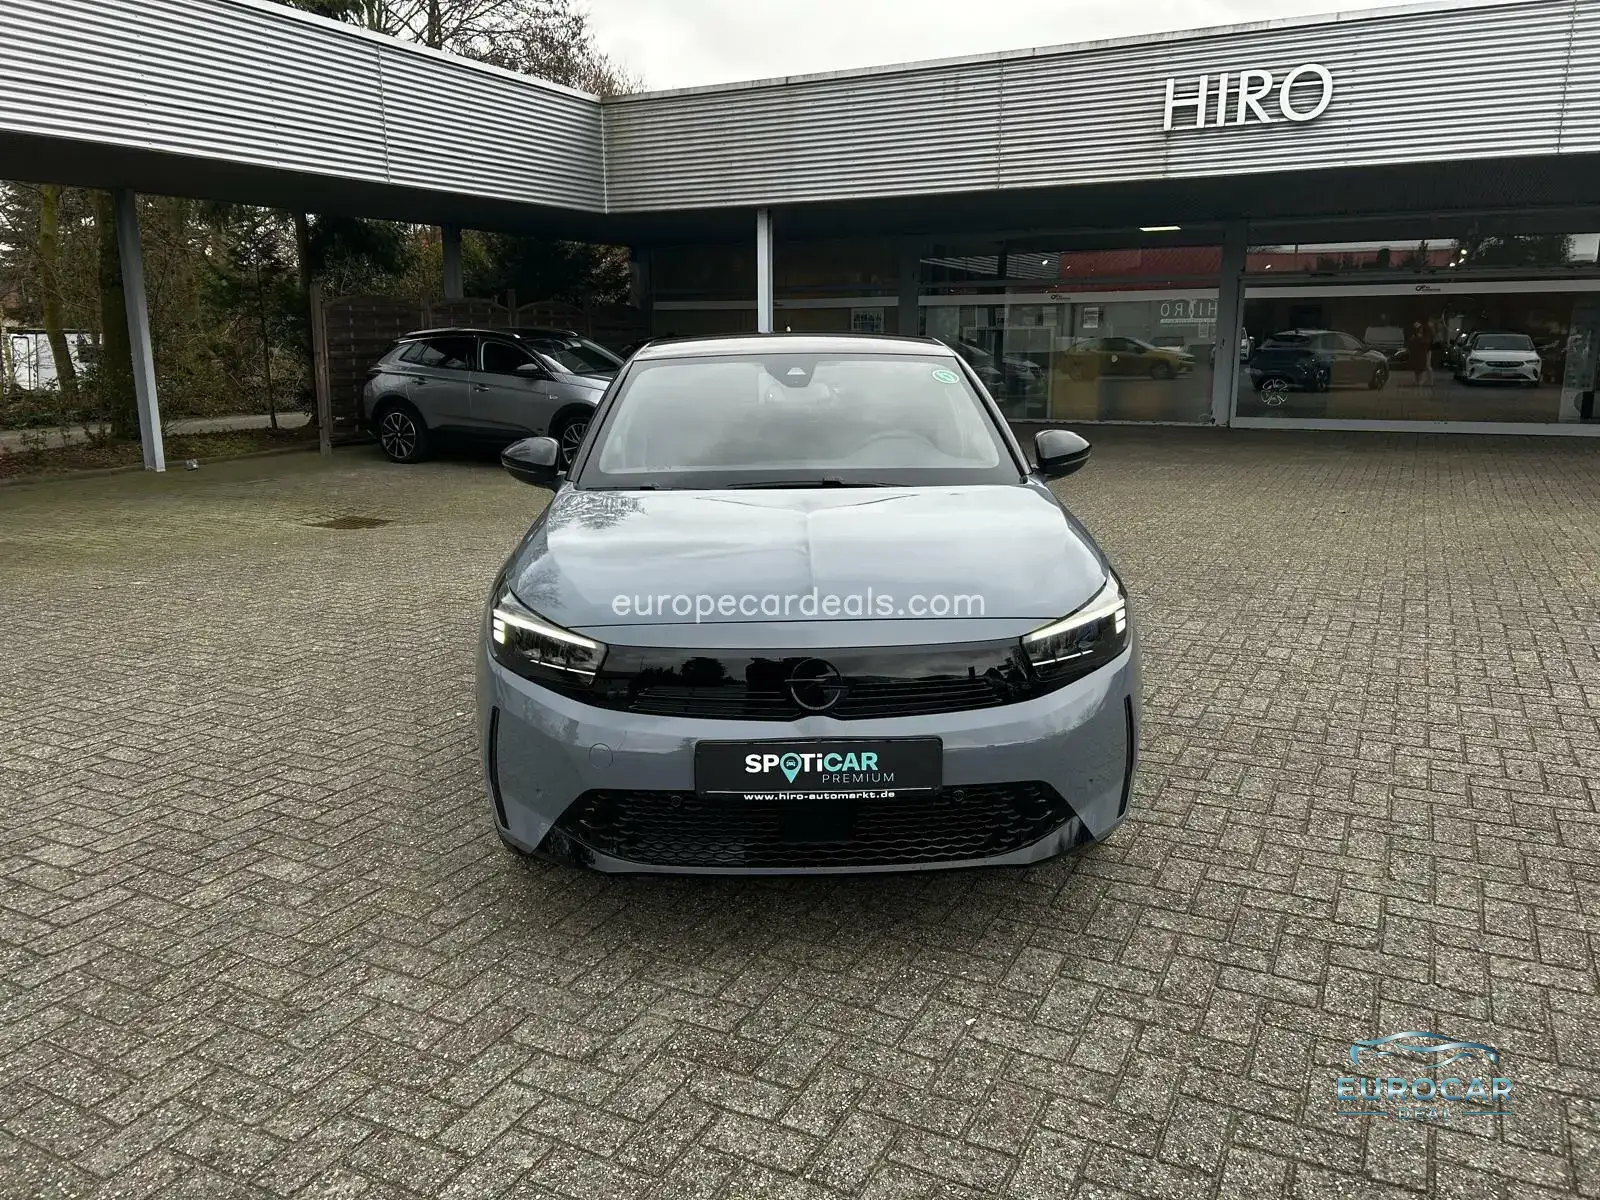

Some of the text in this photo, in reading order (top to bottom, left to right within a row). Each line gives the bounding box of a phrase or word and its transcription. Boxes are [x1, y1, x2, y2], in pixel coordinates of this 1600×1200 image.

[1163, 63, 1333, 131] HIRO
[822, 772, 895, 783] PREMIUM
[743, 790, 895, 801] www.hiro-automarkt.de
